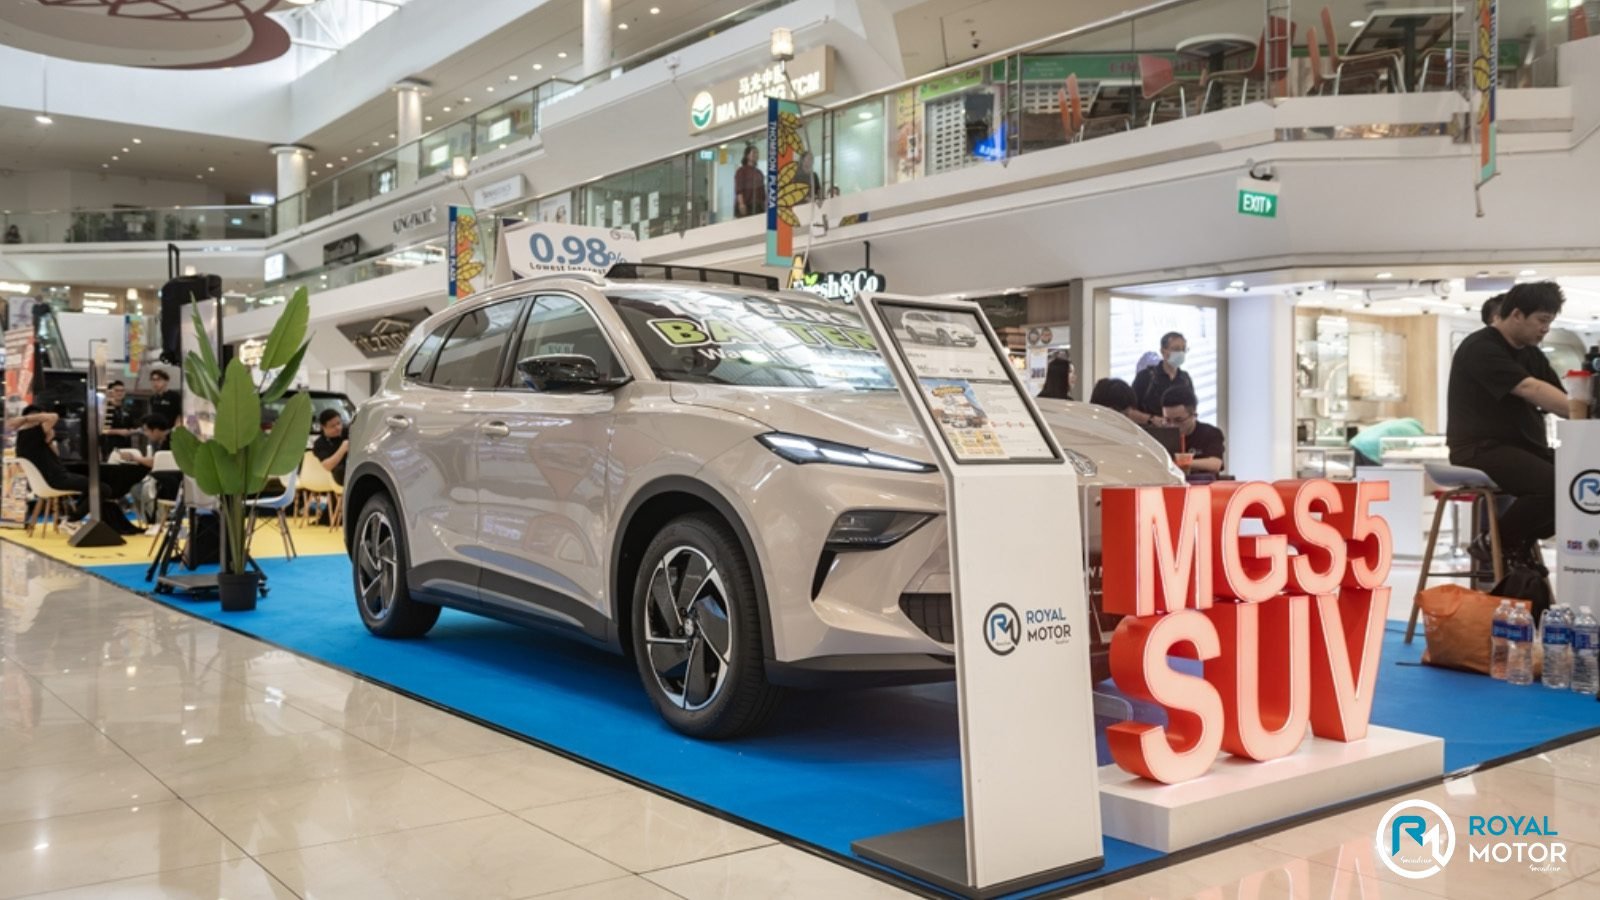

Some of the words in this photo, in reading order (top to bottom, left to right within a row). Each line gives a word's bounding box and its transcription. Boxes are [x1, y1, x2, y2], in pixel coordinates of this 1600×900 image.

[716, 101, 736, 124] MA
[738, 84, 786, 117] KUANG
[791, 71, 820, 98] TCM
[768, 120, 777, 172] THOMSON
[768, 174, 777, 209] PLAZA
[1242, 193, 1266, 213] EXIT
[529, 262, 565, 272] Lowest
[647, 318, 880, 352] BATER
[1102, 479, 1393, 617] MGS5
[1026, 608, 1066, 624] ROYAL
[1027, 625, 1071, 643] MOTOR
[1107, 587, 1392, 784] SUV
